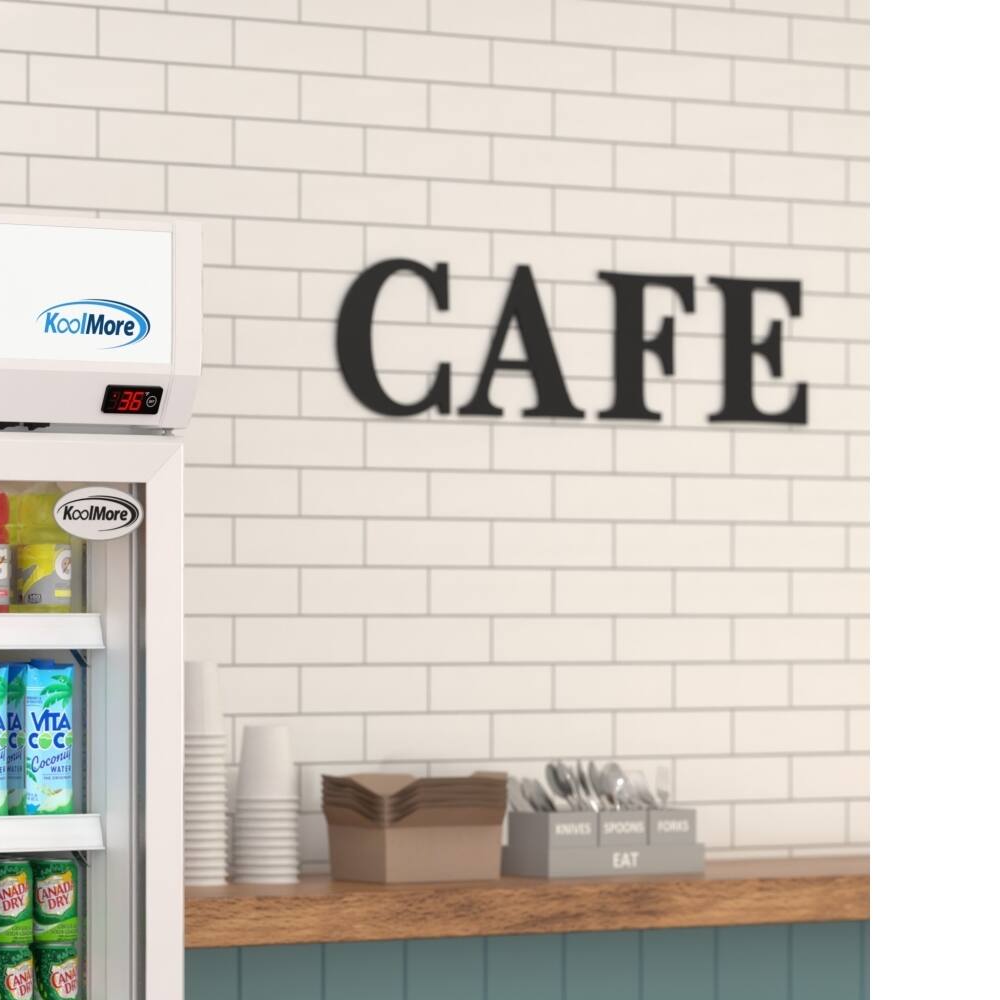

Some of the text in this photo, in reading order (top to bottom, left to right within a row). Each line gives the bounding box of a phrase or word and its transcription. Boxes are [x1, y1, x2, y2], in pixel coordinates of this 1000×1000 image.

[44, 312, 135, 336] KoolMore
[335, 256, 809, 426] CAFE
[117, 391, 144, 411] 36
[62, 505, 128, 521] KoolMore
[31, 709, 71, 732] VITA
[31, 747, 72, 773] Coconut
[555, 823, 592, 835] KNIVES
[603, 821, 645, 834] SPOONS
[657, 819, 690, 832] FORKS
[612, 851, 640, 869] EAT
[2, 895, 24, 912] DRY
[47, 893, 69, 910] DRY
